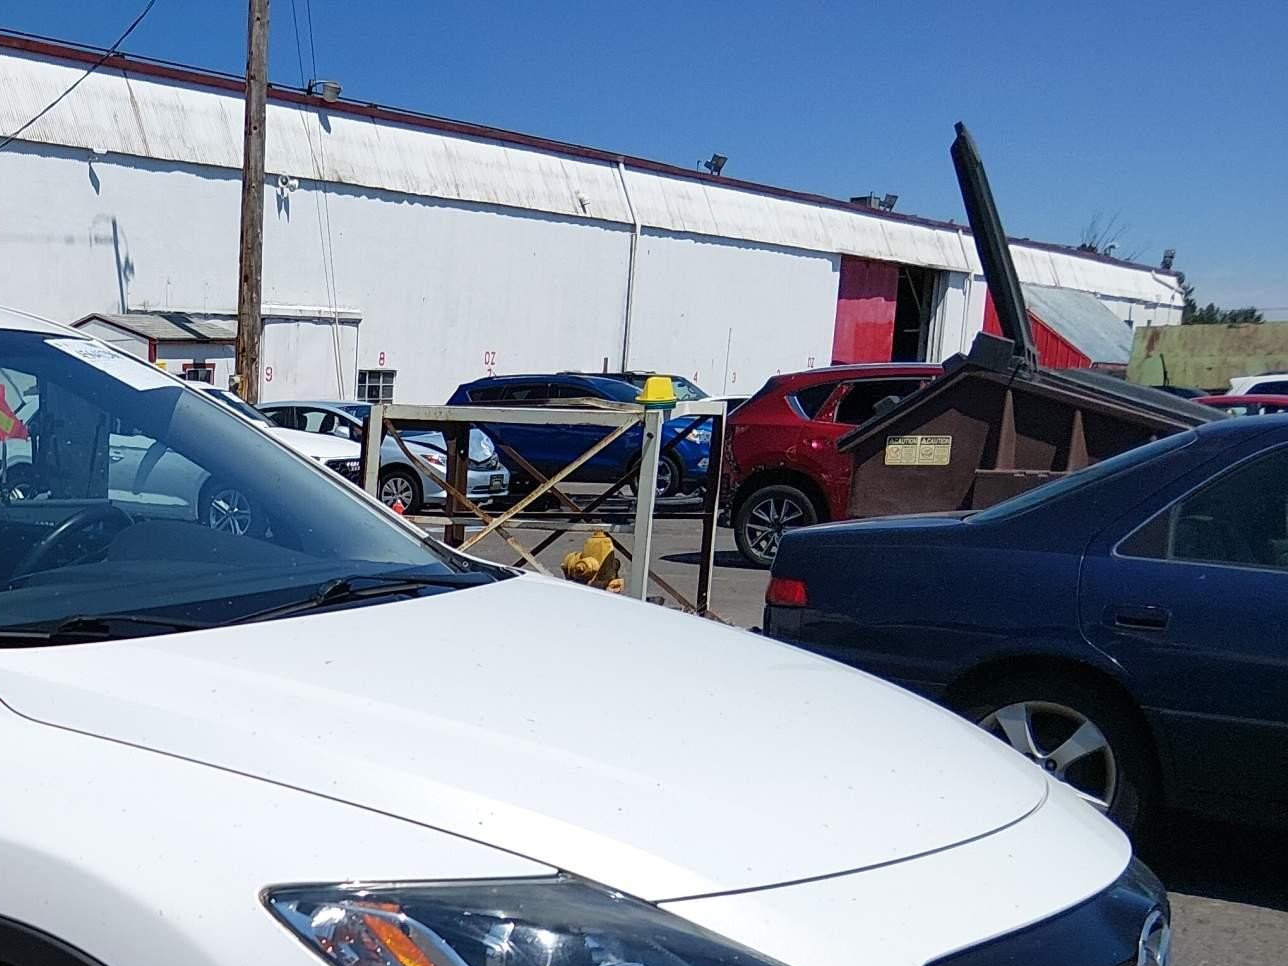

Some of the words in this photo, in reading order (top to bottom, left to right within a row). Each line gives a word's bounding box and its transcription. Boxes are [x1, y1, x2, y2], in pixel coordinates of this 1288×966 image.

[378, 352, 385, 366] 8
[265, 366, 273, 382] 9
[732, 372, 737, 383] 3
